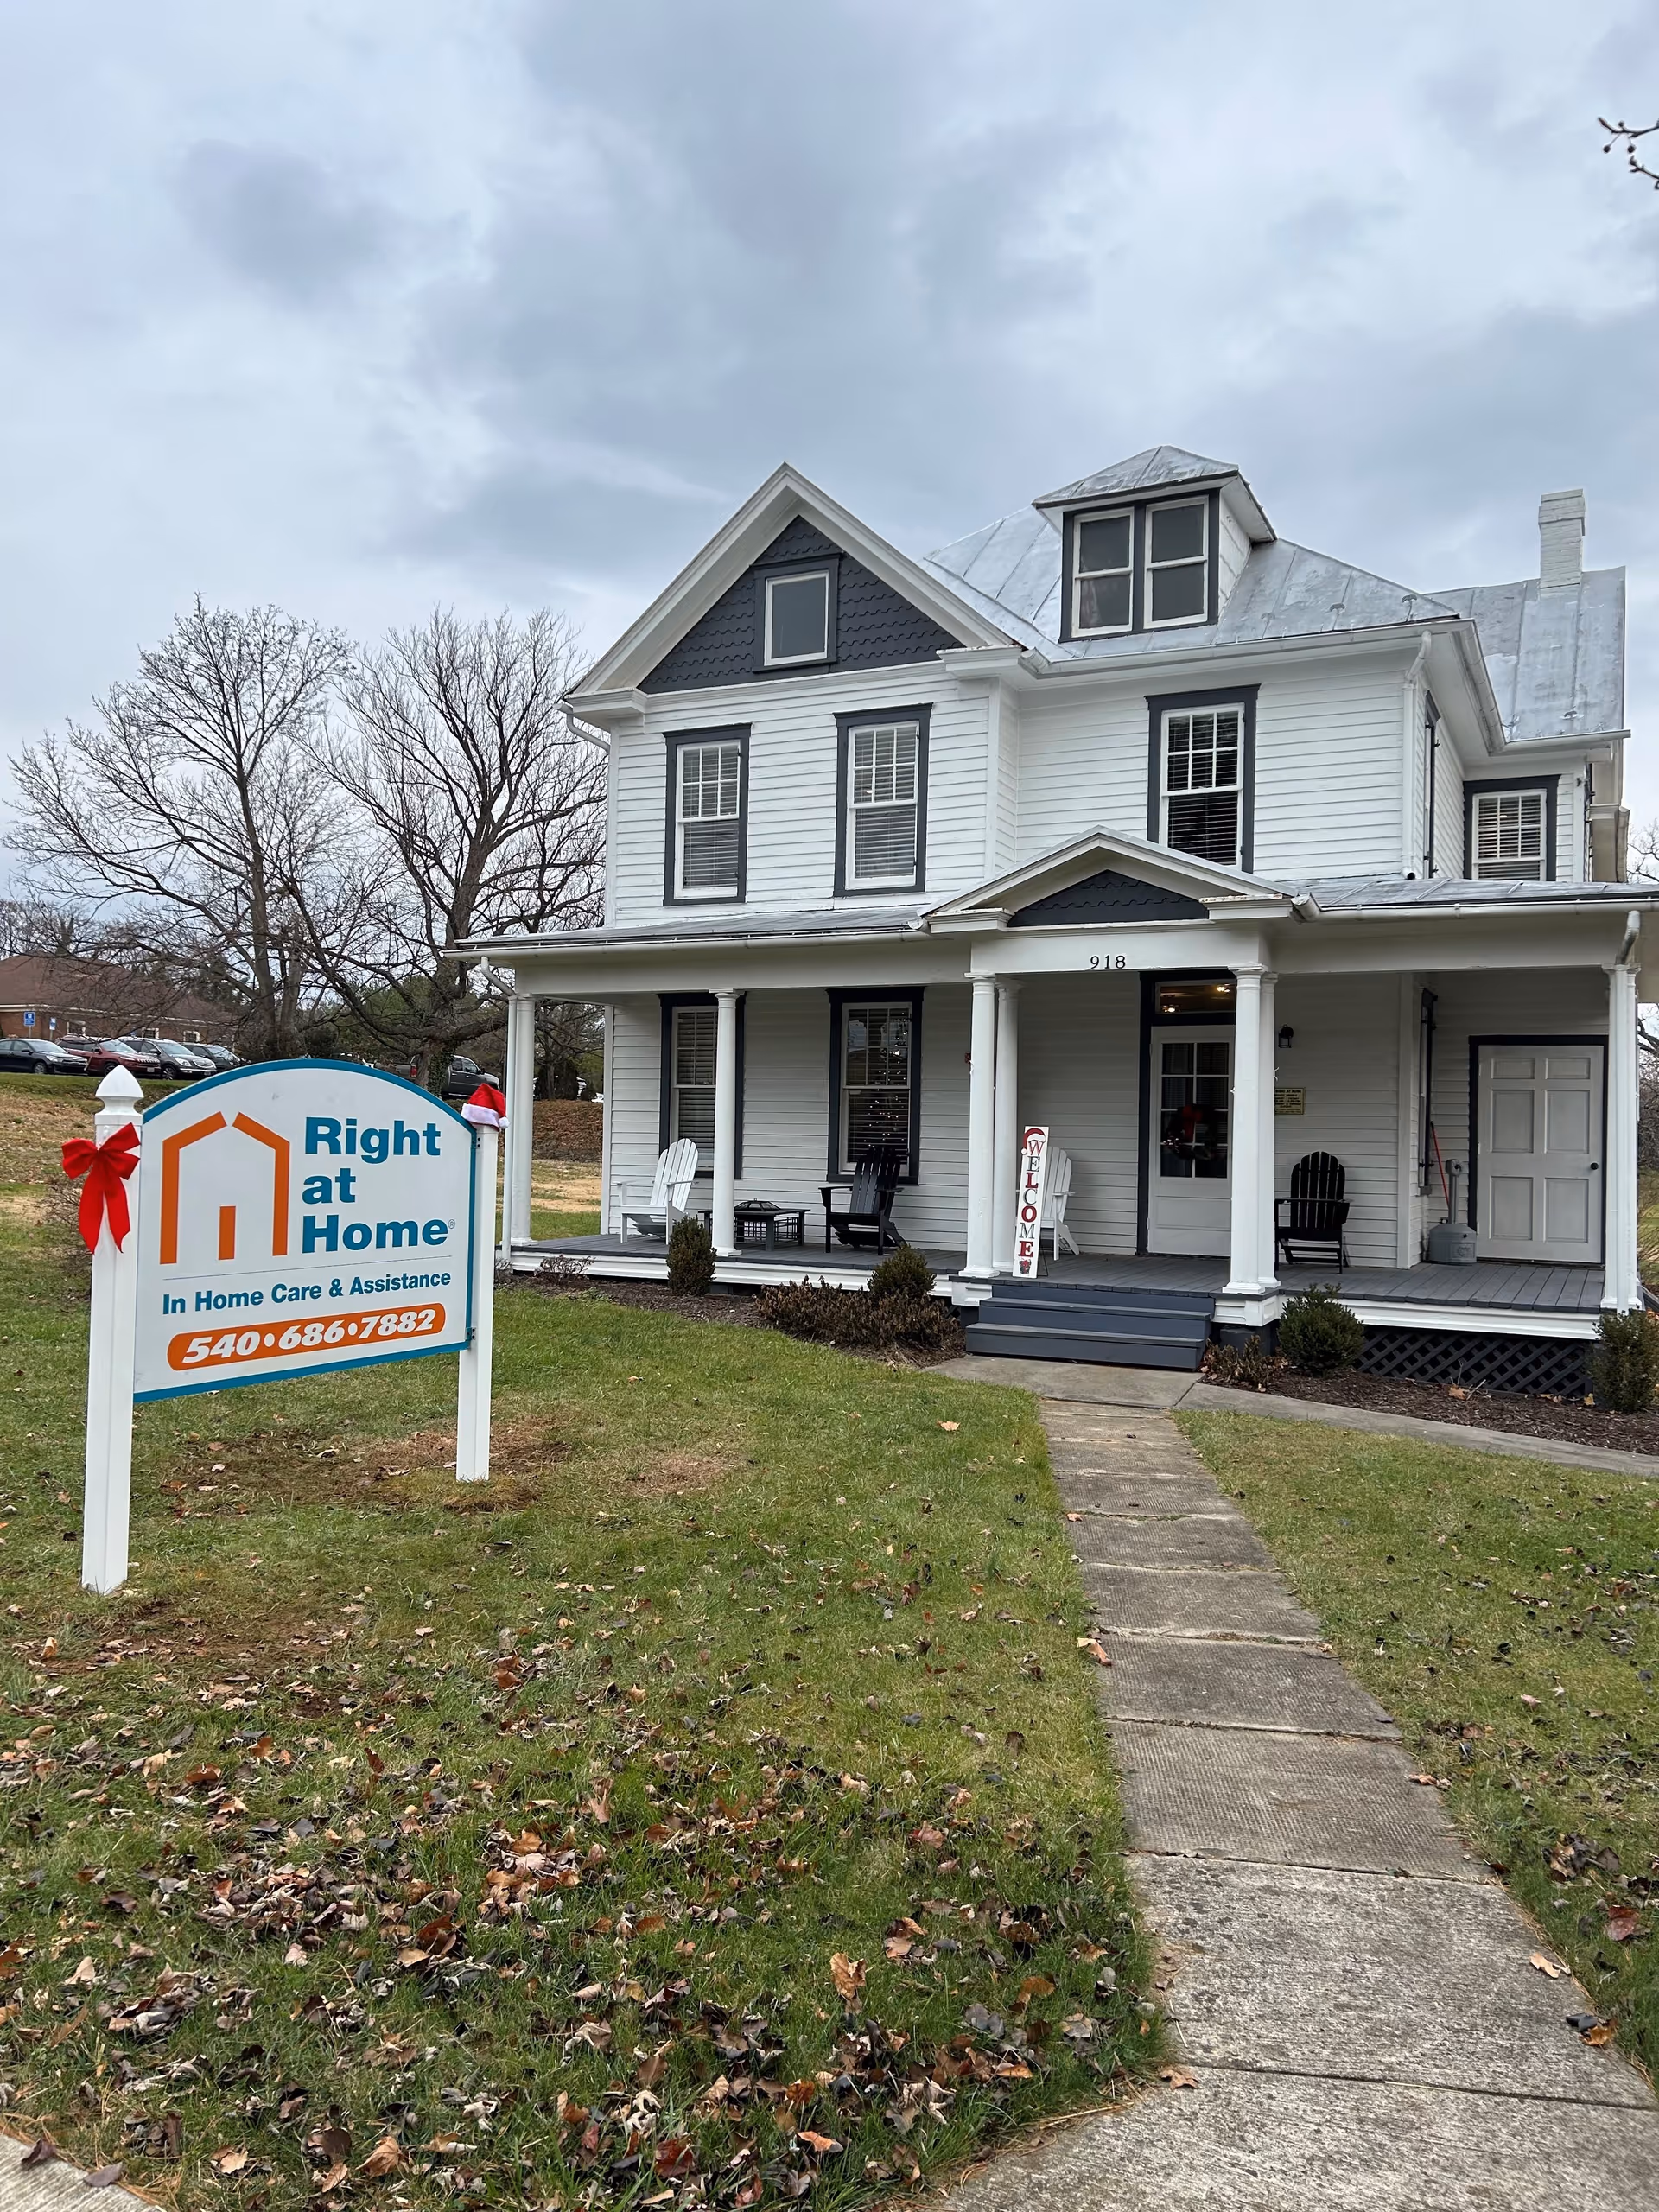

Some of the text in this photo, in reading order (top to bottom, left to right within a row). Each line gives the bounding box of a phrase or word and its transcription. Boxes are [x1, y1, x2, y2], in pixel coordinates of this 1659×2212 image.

[1090, 955, 1127, 969] 918
[305, 1116, 441, 1164] Right
[302, 1168, 356, 1205] at
[1018, 1139, 1045, 1258] WELCOME
[162, 1272, 451, 1314] In Home Care & Assistance
